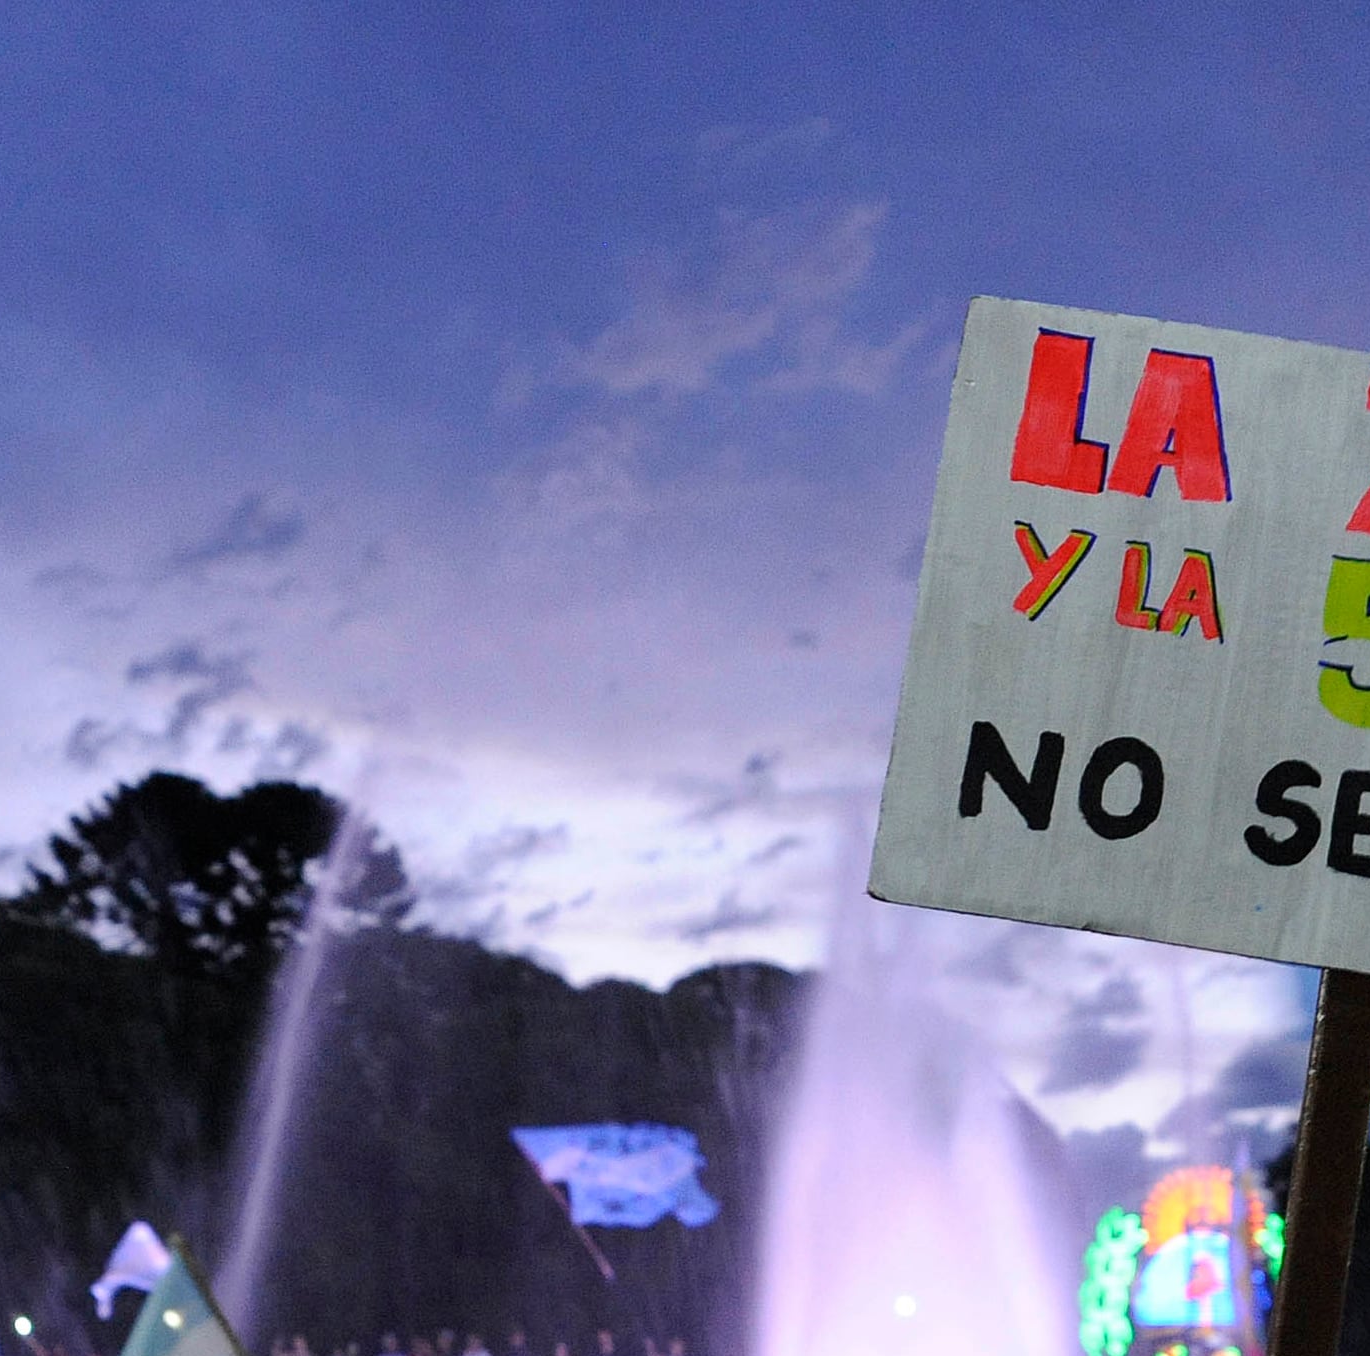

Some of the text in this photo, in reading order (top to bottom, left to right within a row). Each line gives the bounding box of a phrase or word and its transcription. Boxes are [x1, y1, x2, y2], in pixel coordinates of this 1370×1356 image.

[1011, 327, 1231, 502] LA
[1013, 521, 1093, 620] Y
[1115, 540, 1224, 644] LA
[959, 720, 1165, 840] NO
